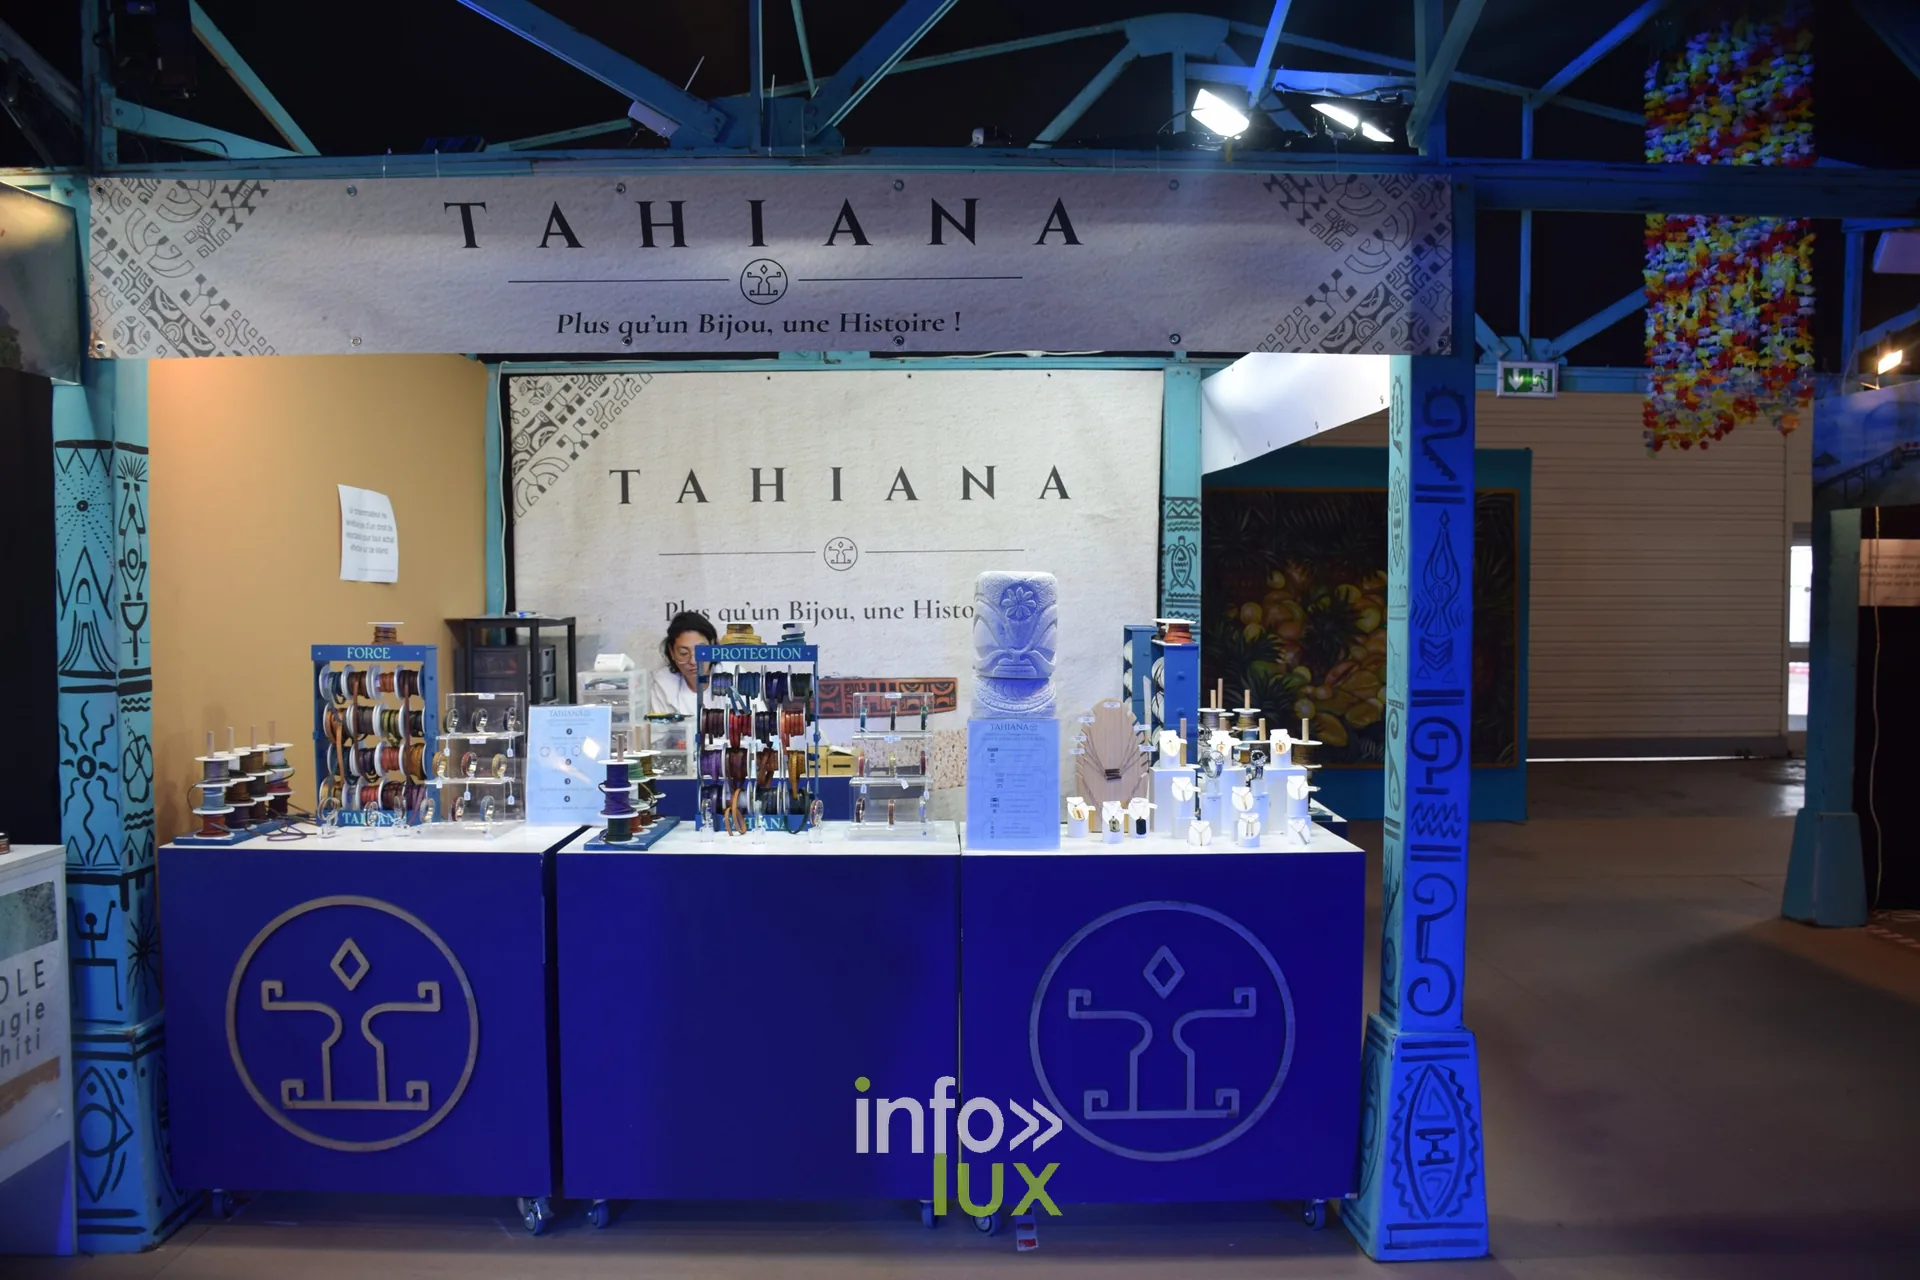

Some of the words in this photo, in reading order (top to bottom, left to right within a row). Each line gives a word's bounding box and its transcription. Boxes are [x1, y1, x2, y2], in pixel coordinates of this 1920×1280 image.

[444, 197, 1084, 249] TAHIANA
[556, 311, 610, 334] Plus
[698, 313, 773, 341] Bijou,
[783, 318, 830, 334] une
[840, 312, 946, 334] Histoire
[955, 311, 961, 332] !
[609, 464, 1072, 505] TAHIANA
[665, 599, 710, 622] Pls
[789, 600, 855, 628] Bijou,
[864, 604, 905, 620] une
[347, 646, 390, 660] FORCE
[711, 647, 802, 660] PROTECTION
[990, 723, 1030, 731] TAHIANA
[0, 1027, 40, 1068] hiti
